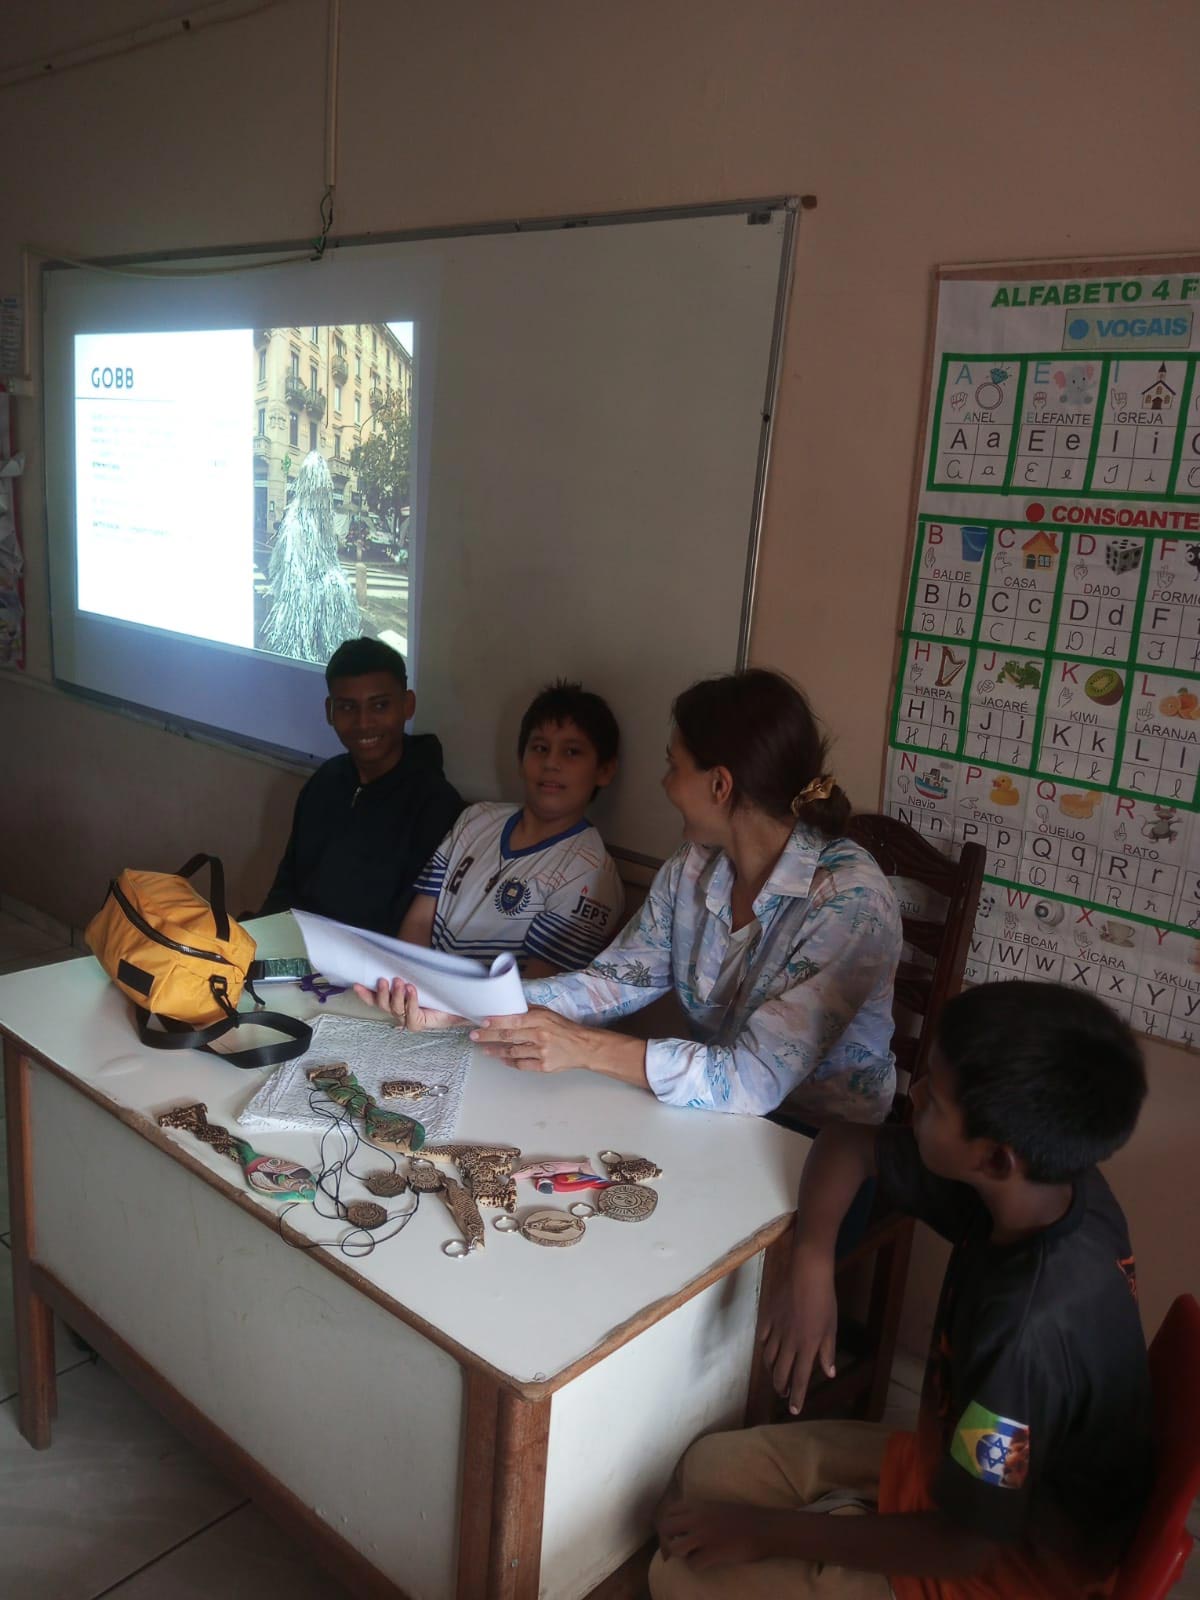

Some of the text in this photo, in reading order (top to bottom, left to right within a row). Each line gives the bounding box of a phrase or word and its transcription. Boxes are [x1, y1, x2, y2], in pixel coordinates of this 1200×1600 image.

[991, 281, 1142, 308] ALFABETO
[1152, 280, 1169, 300] 4
[1097, 317, 1187, 337] VOGAIS
[91, 367, 134, 388] GOBB
[955, 364, 973, 384] A
[1034, 361, 1051, 384] E
[963, 412, 995, 423] ANEL
[1026, 412, 1091, 425] ELEFANTE
[1113, 412, 1163, 425] IGREJA
[950, 428, 1001, 450] A a
[1028, 430, 1081, 451] E e
[1152, 431, 1159, 454] i
[1052, 505, 1199, 530] CONSOANTE
[928, 524, 943, 544] B
[998, 527, 1016, 548] C
[1077, 534, 1096, 555] D
[1159, 538, 1178, 560] F
[932, 568, 972, 582] BALDE
[1003, 576, 1037, 589] CASA
[924, 583, 972, 608] B b
[1083, 583, 1121, 597] DADO
[1151, 589, 1200, 605] FORMI
[991, 591, 1009, 613] C
[1069, 599, 1124, 626] D d
[1151, 607, 1171, 629] F
[914, 641, 931, 662] H
[984, 652, 996, 671] J
[1061, 662, 1080, 684] K
[915, 686, 953, 700] HARPA
[1141, 674, 1156, 696] L
[908, 699, 955, 725] H h
[981, 696, 1028, 713] JACARÉ
[979, 711, 1025, 739] J j
[1069, 711, 1098, 725] KIWI
[1052, 723, 1071, 746] K
[1134, 722, 1197, 742] LARANJA
[1135, 739, 1149, 762] L
[900, 752, 917, 773] N
[966, 766, 982, 785] P
[1037, 780, 1057, 802] Q
[907, 796, 936, 810] Navio
[1116, 796, 1135, 819] R
[930, 817, 942, 833] n
[973, 810, 1004, 825] PATO
[962, 823, 1011, 848] P p
[1038, 823, 1085, 841] QUEIJO
[1033, 837, 1086, 867] Q q
[1123, 844, 1159, 860] RATO
[1108, 856, 1163, 883] R r
[898, 899, 920, 913] ATU
[1007, 888, 1031, 909] W
[1076, 906, 1094, 927] X
[1003, 928, 1058, 951] WEBCAM
[999, 943, 1024, 966] W
[1071, 962, 1091, 986] X
[1153, 969, 1200, 992] YAKULT
[1147, 983, 1166, 1006] Y
